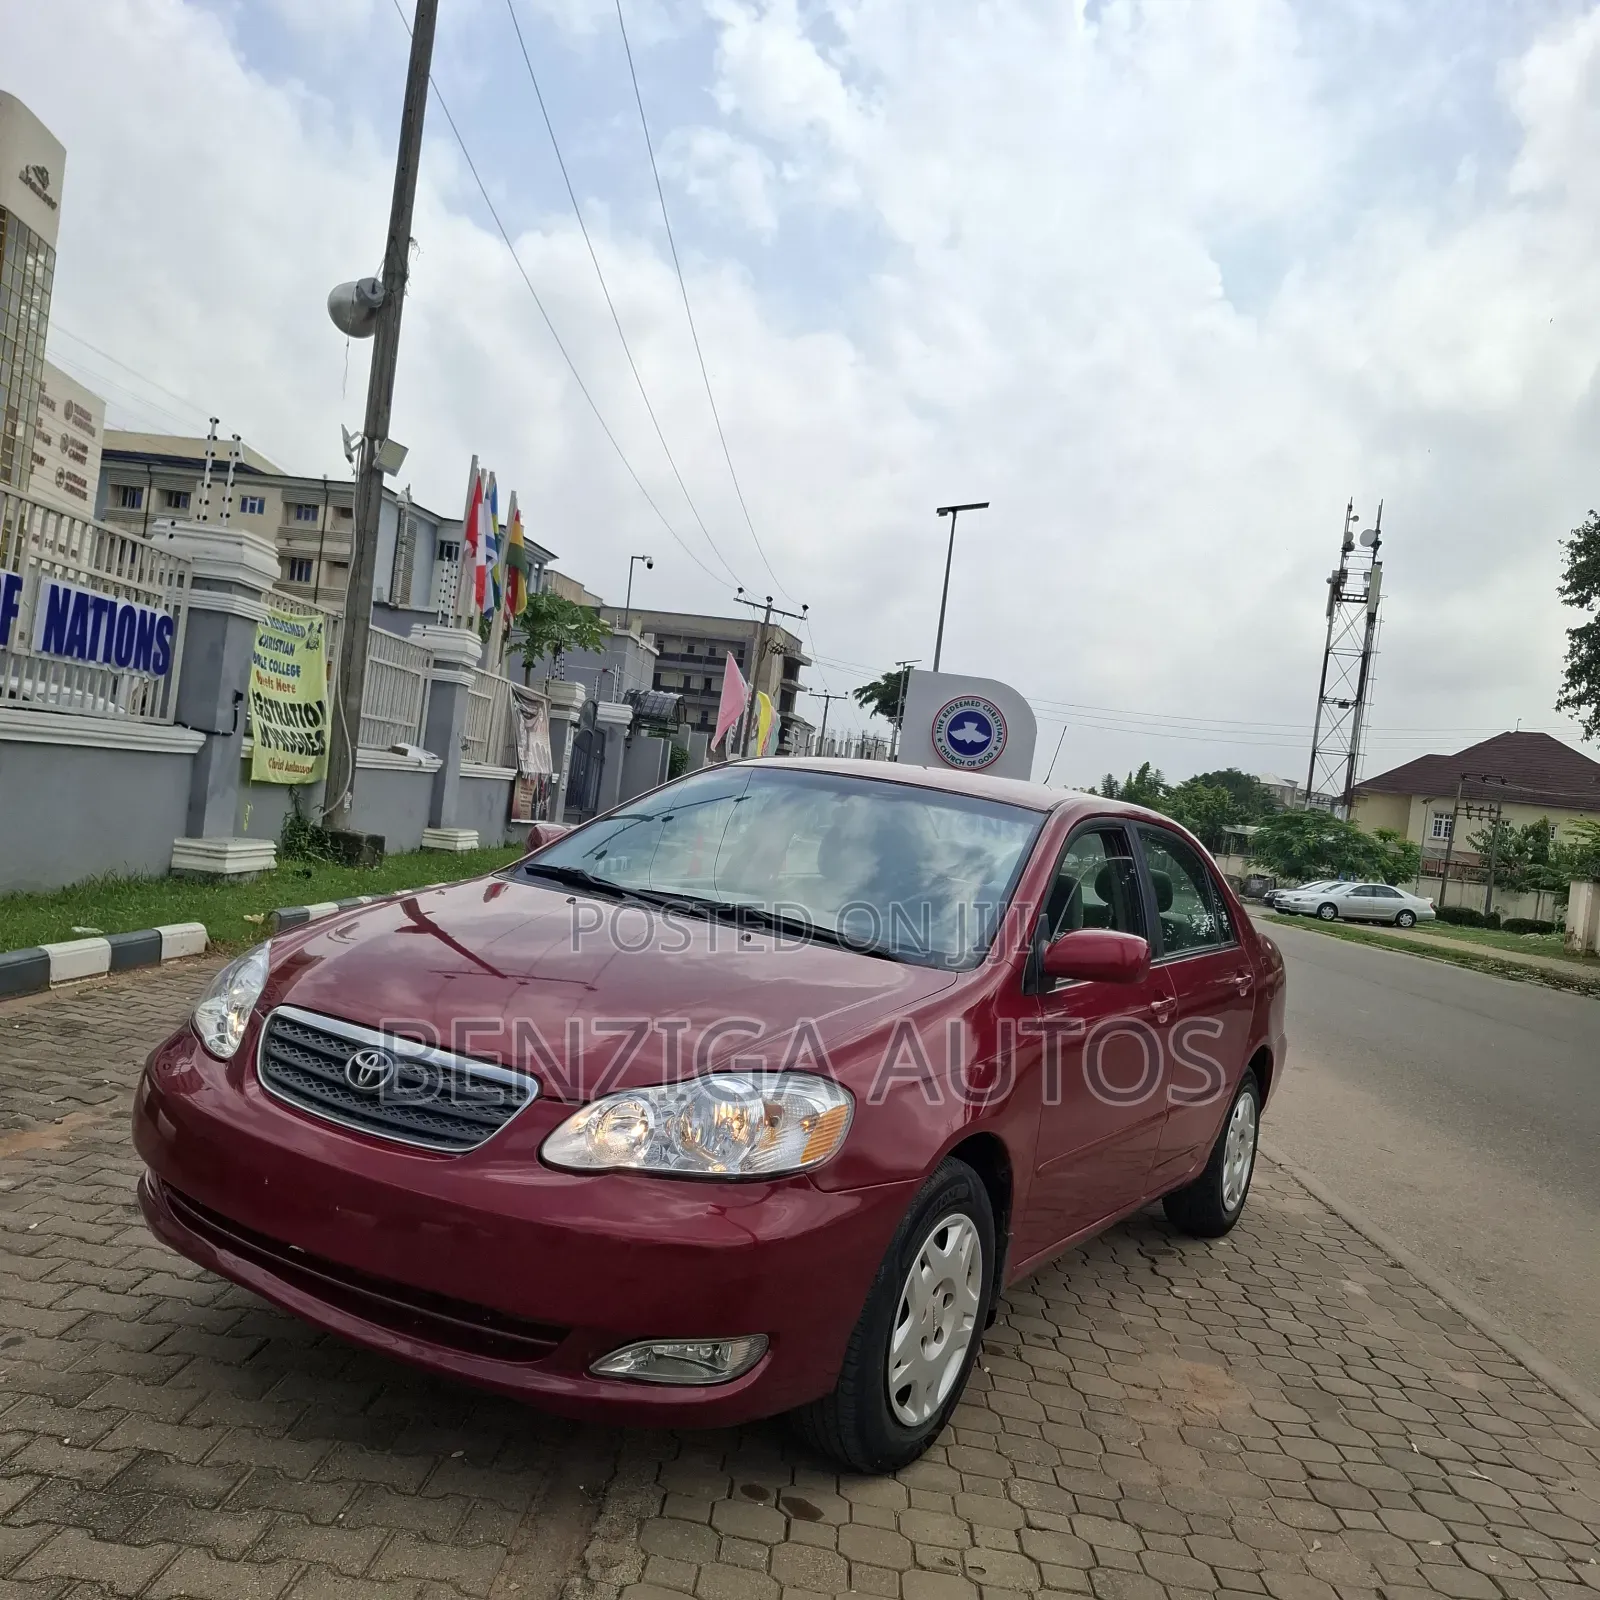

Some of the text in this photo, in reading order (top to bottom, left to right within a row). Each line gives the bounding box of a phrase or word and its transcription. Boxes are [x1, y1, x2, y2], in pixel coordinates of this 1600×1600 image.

[0, 574, 173, 675] F NATIONS
[258, 634, 296, 657] CHRISTIAN
[269, 659, 301, 678] COLLEGE
[276, 678, 297, 694] Here
[936, 700, 1004, 744] THE REDEEMED CHRISTIAN
[268, 757, 283, 771] Christ
[940, 745, 994, 767] CHURCH OF GOD
